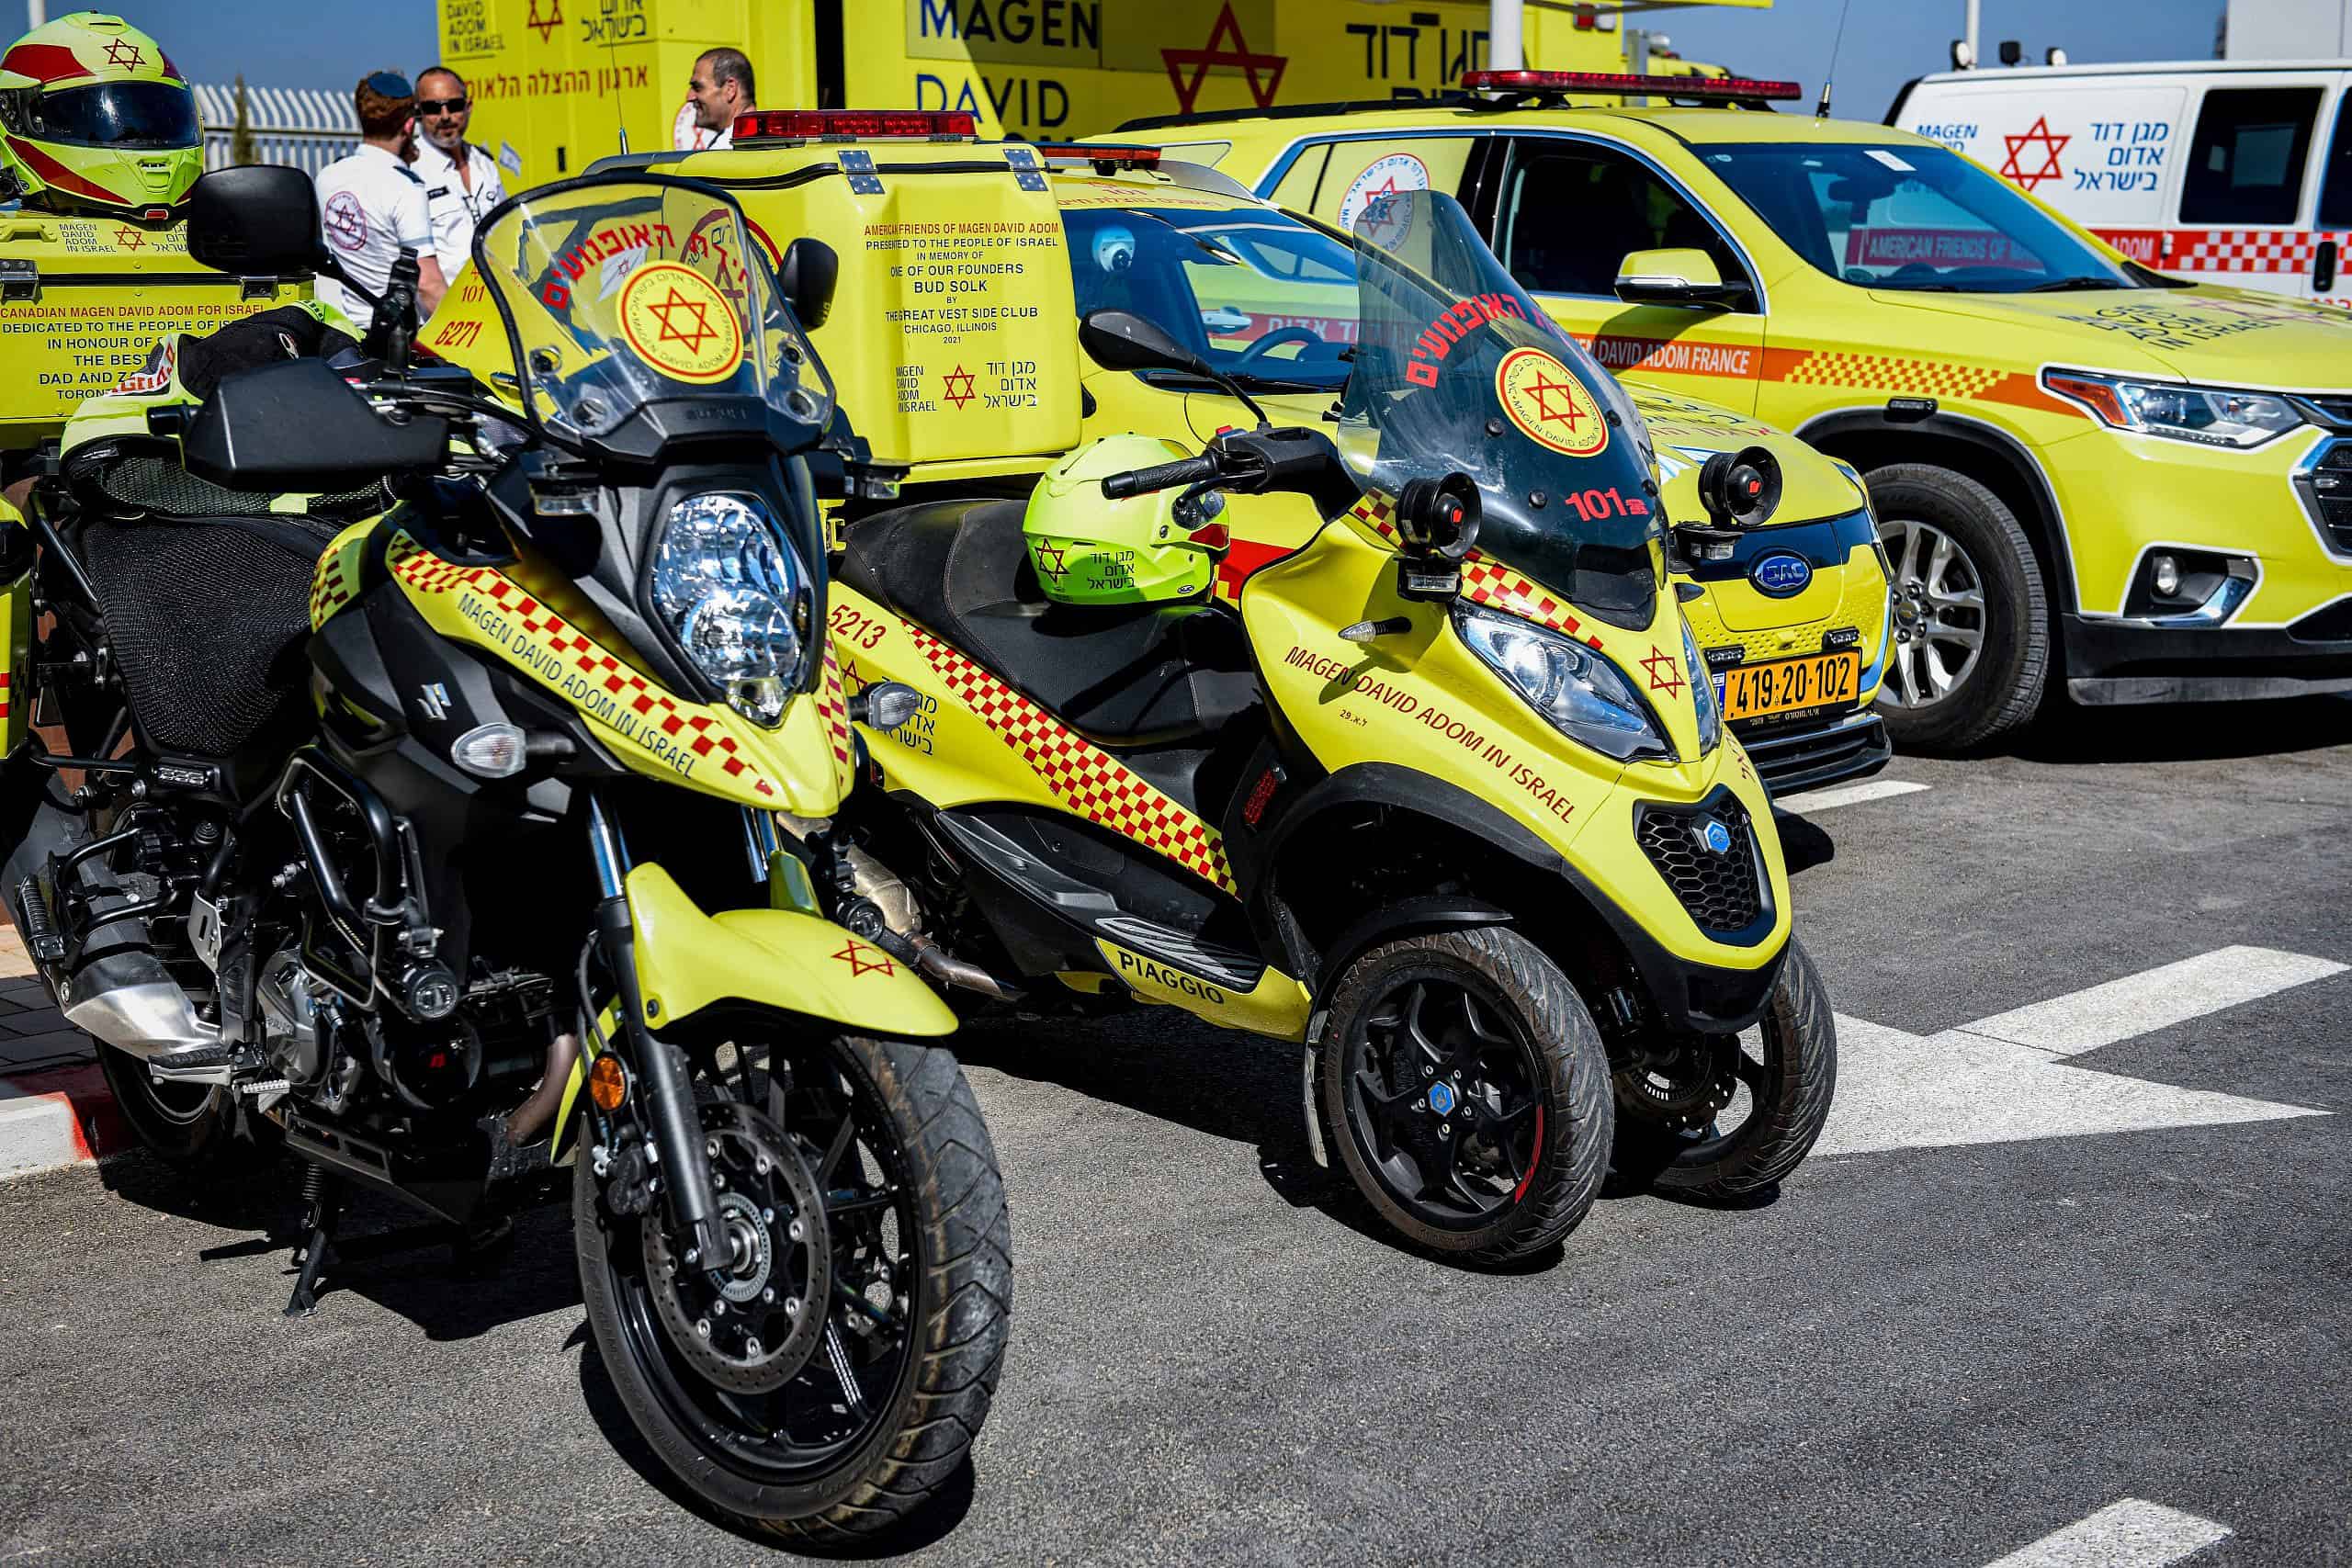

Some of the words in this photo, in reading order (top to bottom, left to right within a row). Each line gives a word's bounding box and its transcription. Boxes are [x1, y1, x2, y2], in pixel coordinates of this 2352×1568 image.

[448, 18, 486, 36] ADOM
[921, 0, 1099, 49] MAGEN
[465, 34, 505, 52] ISRAEL
[1346, 23, 1419, 79] דוד
[527, 69, 590, 96] ההצלה
[916, 73, 1069, 127] DAVID
[1917, 124, 1978, 139] MAGEN
[2090, 123, 2125, 141] דוד
[2132, 122, 2169, 143] מגן
[2107, 147, 2164, 166] אדום
[2074, 169, 2158, 192] בישראל
[898, 224, 941, 235] FRIENDS
[943, 223, 956, 234] OF
[958, 223, 991, 234] MAGEN
[993, 223, 1024, 233] DAVID
[1029, 222, 1058, 233] ADOM
[913, 239, 927, 249] TO
[930, 238, 950, 248] THE
[954, 238, 993, 248] PEOPLE
[997, 238, 1011, 246] OF
[1016, 237, 1058, 246] ISRAEL
[1869, 235, 1932, 260] AMERICAN
[1935, 235, 1986, 260] FRIENDS
[1989, 236, 2007, 260] OF
[917, 253, 926, 261] IN
[930, 252, 968, 261] MEMORY
[972, 251, 984, 259] OF
[890, 266, 902, 277] ONE
[908, 265, 923, 276] OF
[928, 265, 954, 276] OUR
[957, 264, 1023, 275] FOUNDERS
[462, 286, 485, 302] 101
[914, 281, 944, 294] BUD
[950, 280, 988, 292] SOLK
[946, 296, 957, 304] BY
[1, 308, 66, 319] CANADIAN
[70, 307, 117, 318] MAGEN
[119, 307, 154, 318] DAVID
[158, 306, 194, 317] ADOM
[198, 305, 221, 316] FOR
[886, 311, 898, 322] THE
[898, 310, 935, 321] GREAT
[939, 309, 968, 320] VEST
[972, 308, 998, 318] SIDE
[1001, 307, 1038, 317] CLUB
[3, 322, 83, 333] DEDICATED
[85, 322, 104, 333] TO
[107, 321, 134, 332] THE
[139, 321, 192, 332] PEOPLE
[197, 320, 214, 331] OF
[904, 323, 955, 334] CHICAGO,
[957, 322, 997, 332] ILLINOIS
[435, 321, 483, 349] 6271
[943, 336, 961, 344] 2021
[1406, 293, 1528, 389] האופנועים
[48, 339, 62, 349] IN
[66, 337, 129, 349] HONOUR
[134, 337, 153, 347] OF
[74, 355, 104, 367] THE
[110, 355, 151, 366] BEST
[1599, 340, 1642, 366] DAVID
[1643, 343, 1690, 369] ADOM
[1691, 346, 1750, 375] FRANCE
[987, 362, 1005, 375] דוד
[1012, 361, 1036, 376] מגן
[40, 373, 74, 385] DAD
[79, 372, 112, 384] AND
[1001, 378, 1036, 391] אדום
[56, 389, 109, 400] TORON
[984, 393, 1037, 409] בישראל
[904, 401, 937, 412] ISRAEL
[1565, 487, 1628, 522] 101
[1090, 552, 1110, 564] דוד
[1115, 550, 1134, 565] מגן
[1104, 564, 1135, 577] אדום
[1087, 577, 1135, 590] בישראל
[827, 604, 887, 649] 5213
[458, 592, 513, 645] MAGEN
[512, 634, 562, 682] DAVID
[560, 673, 616, 722] ADOM
[616, 710, 639, 737] IN
[638, 726, 695, 780] ISRAEL
[1284, 645, 1355, 686] MAGEN
[1354, 675, 1419, 714] DAVID
[1416, 707, 1484, 752] ADOM
[1481, 743, 1511, 769] IN
[1509, 762, 1577, 825] ISRAEL
[1117, 950, 1225, 1005] PIAGGIO
